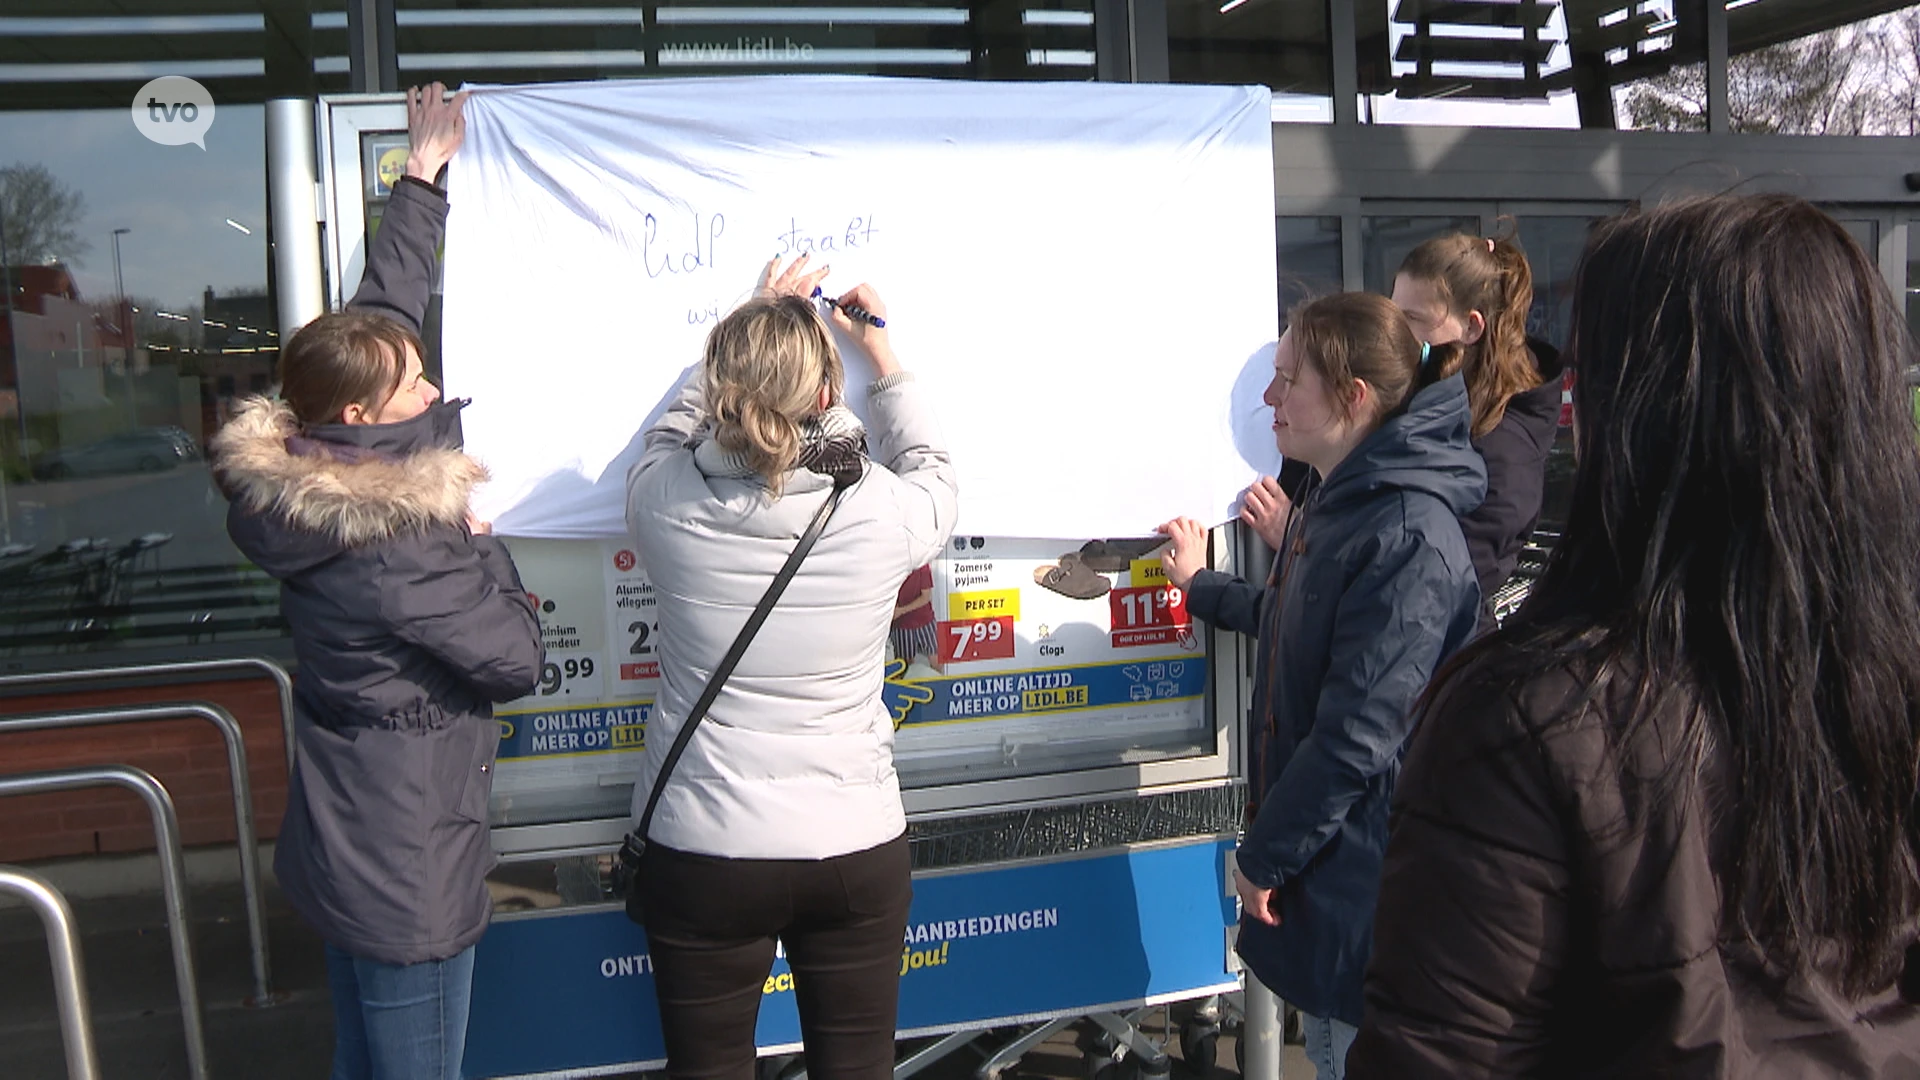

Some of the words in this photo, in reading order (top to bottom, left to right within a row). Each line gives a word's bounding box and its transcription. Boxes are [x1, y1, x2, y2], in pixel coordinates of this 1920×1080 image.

[663, 37, 815, 61] www.lidl.be
[954, 562, 994, 574] Zomerse
[1144, 566, 1167, 578] SLEC
[616, 582, 655, 596] Alumin
[954, 573, 990, 588] pyjama
[965, 599, 986, 611] PER
[988, 597, 1006, 609] SET
[1120, 588, 1182, 627] 11.99
[541, 624, 577, 637] inium
[627, 620, 659, 655] 2
[950, 620, 1002, 659] 7.99
[542, 637, 581, 650] endeur
[1039, 644, 1065, 657] Clogs
[951, 676, 1014, 697] ONLINE
[1017, 672, 1072, 692] ALTIJD
[948, 696, 992, 716] MEER
[996, 694, 1020, 711] OP
[1026, 689, 1084, 708] LIDL.BE
[533, 711, 601, 732] ONLINE
[531, 733, 580, 752] MEER
[583, 730, 609, 747] OP
[615, 727, 645, 745] LID
[600, 954, 654, 979] ONT
[899, 940, 950, 977] jou!
